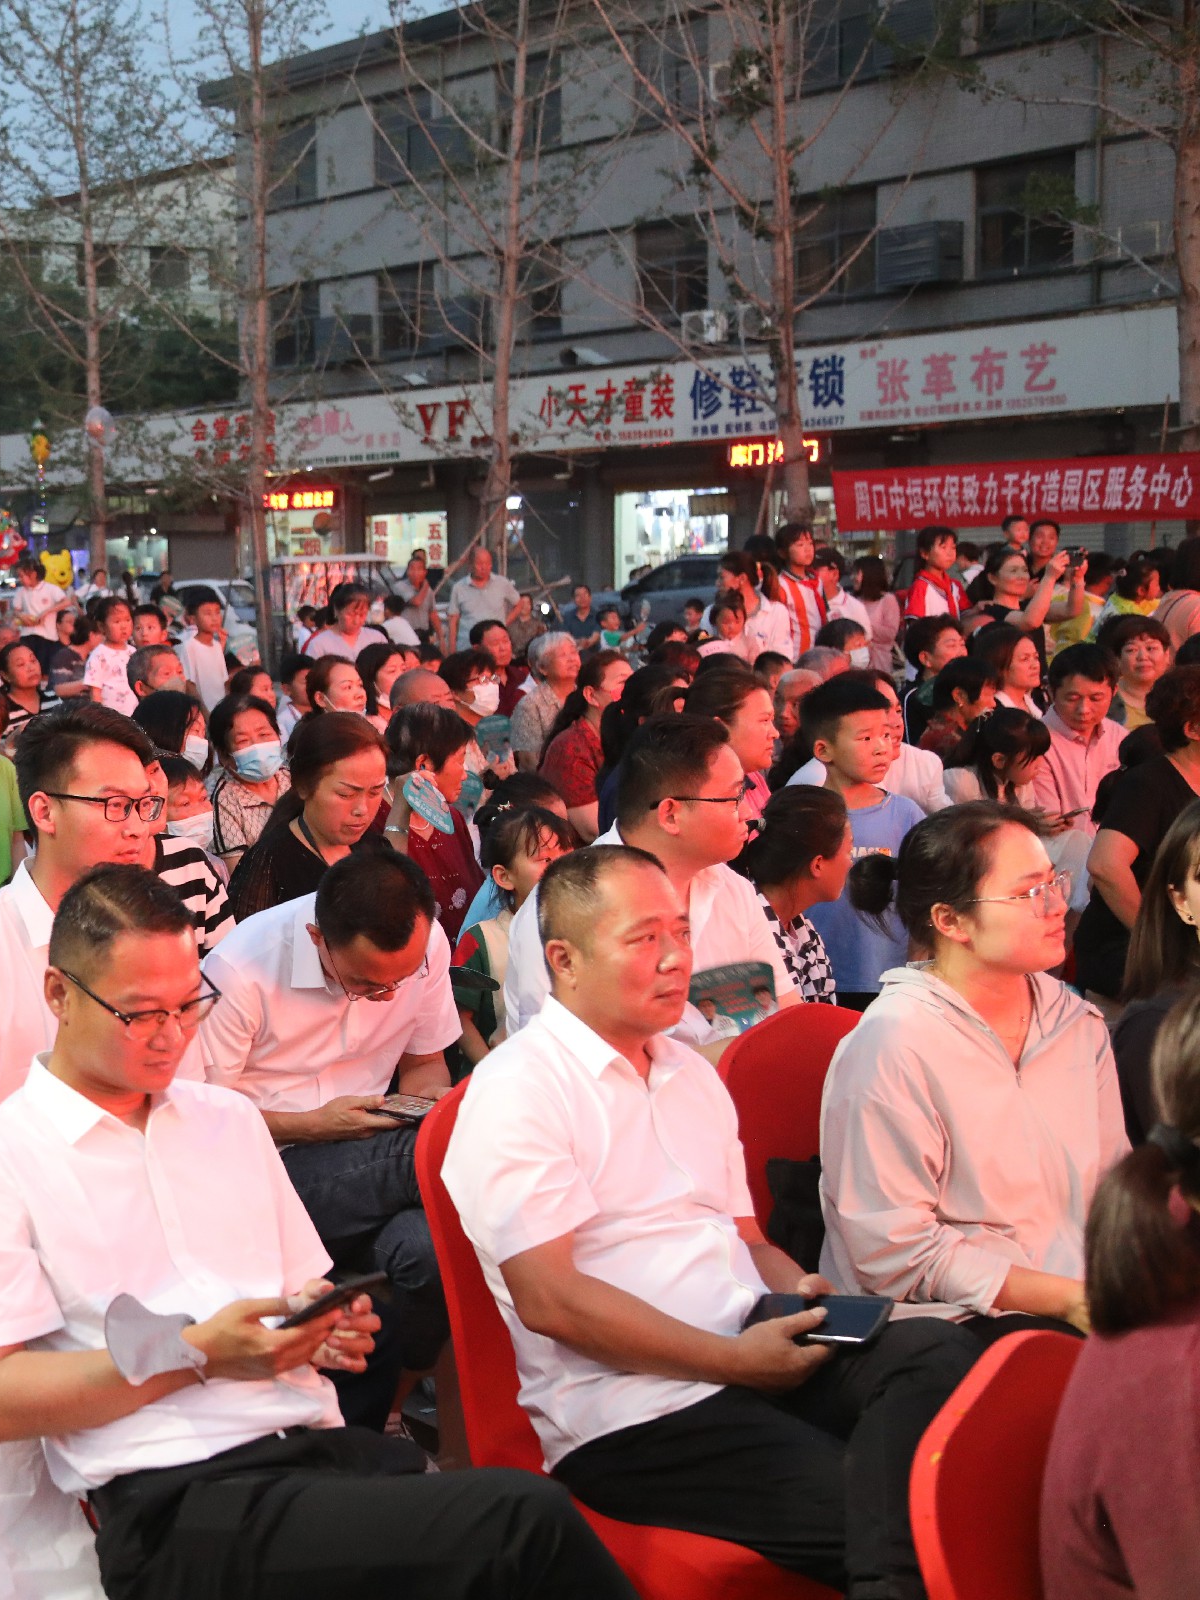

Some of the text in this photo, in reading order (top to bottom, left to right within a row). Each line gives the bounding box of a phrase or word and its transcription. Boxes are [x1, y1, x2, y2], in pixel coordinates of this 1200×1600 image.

[540, 373, 676, 428] 小天才童装
[876, 342, 1058, 406] 张革布艺
